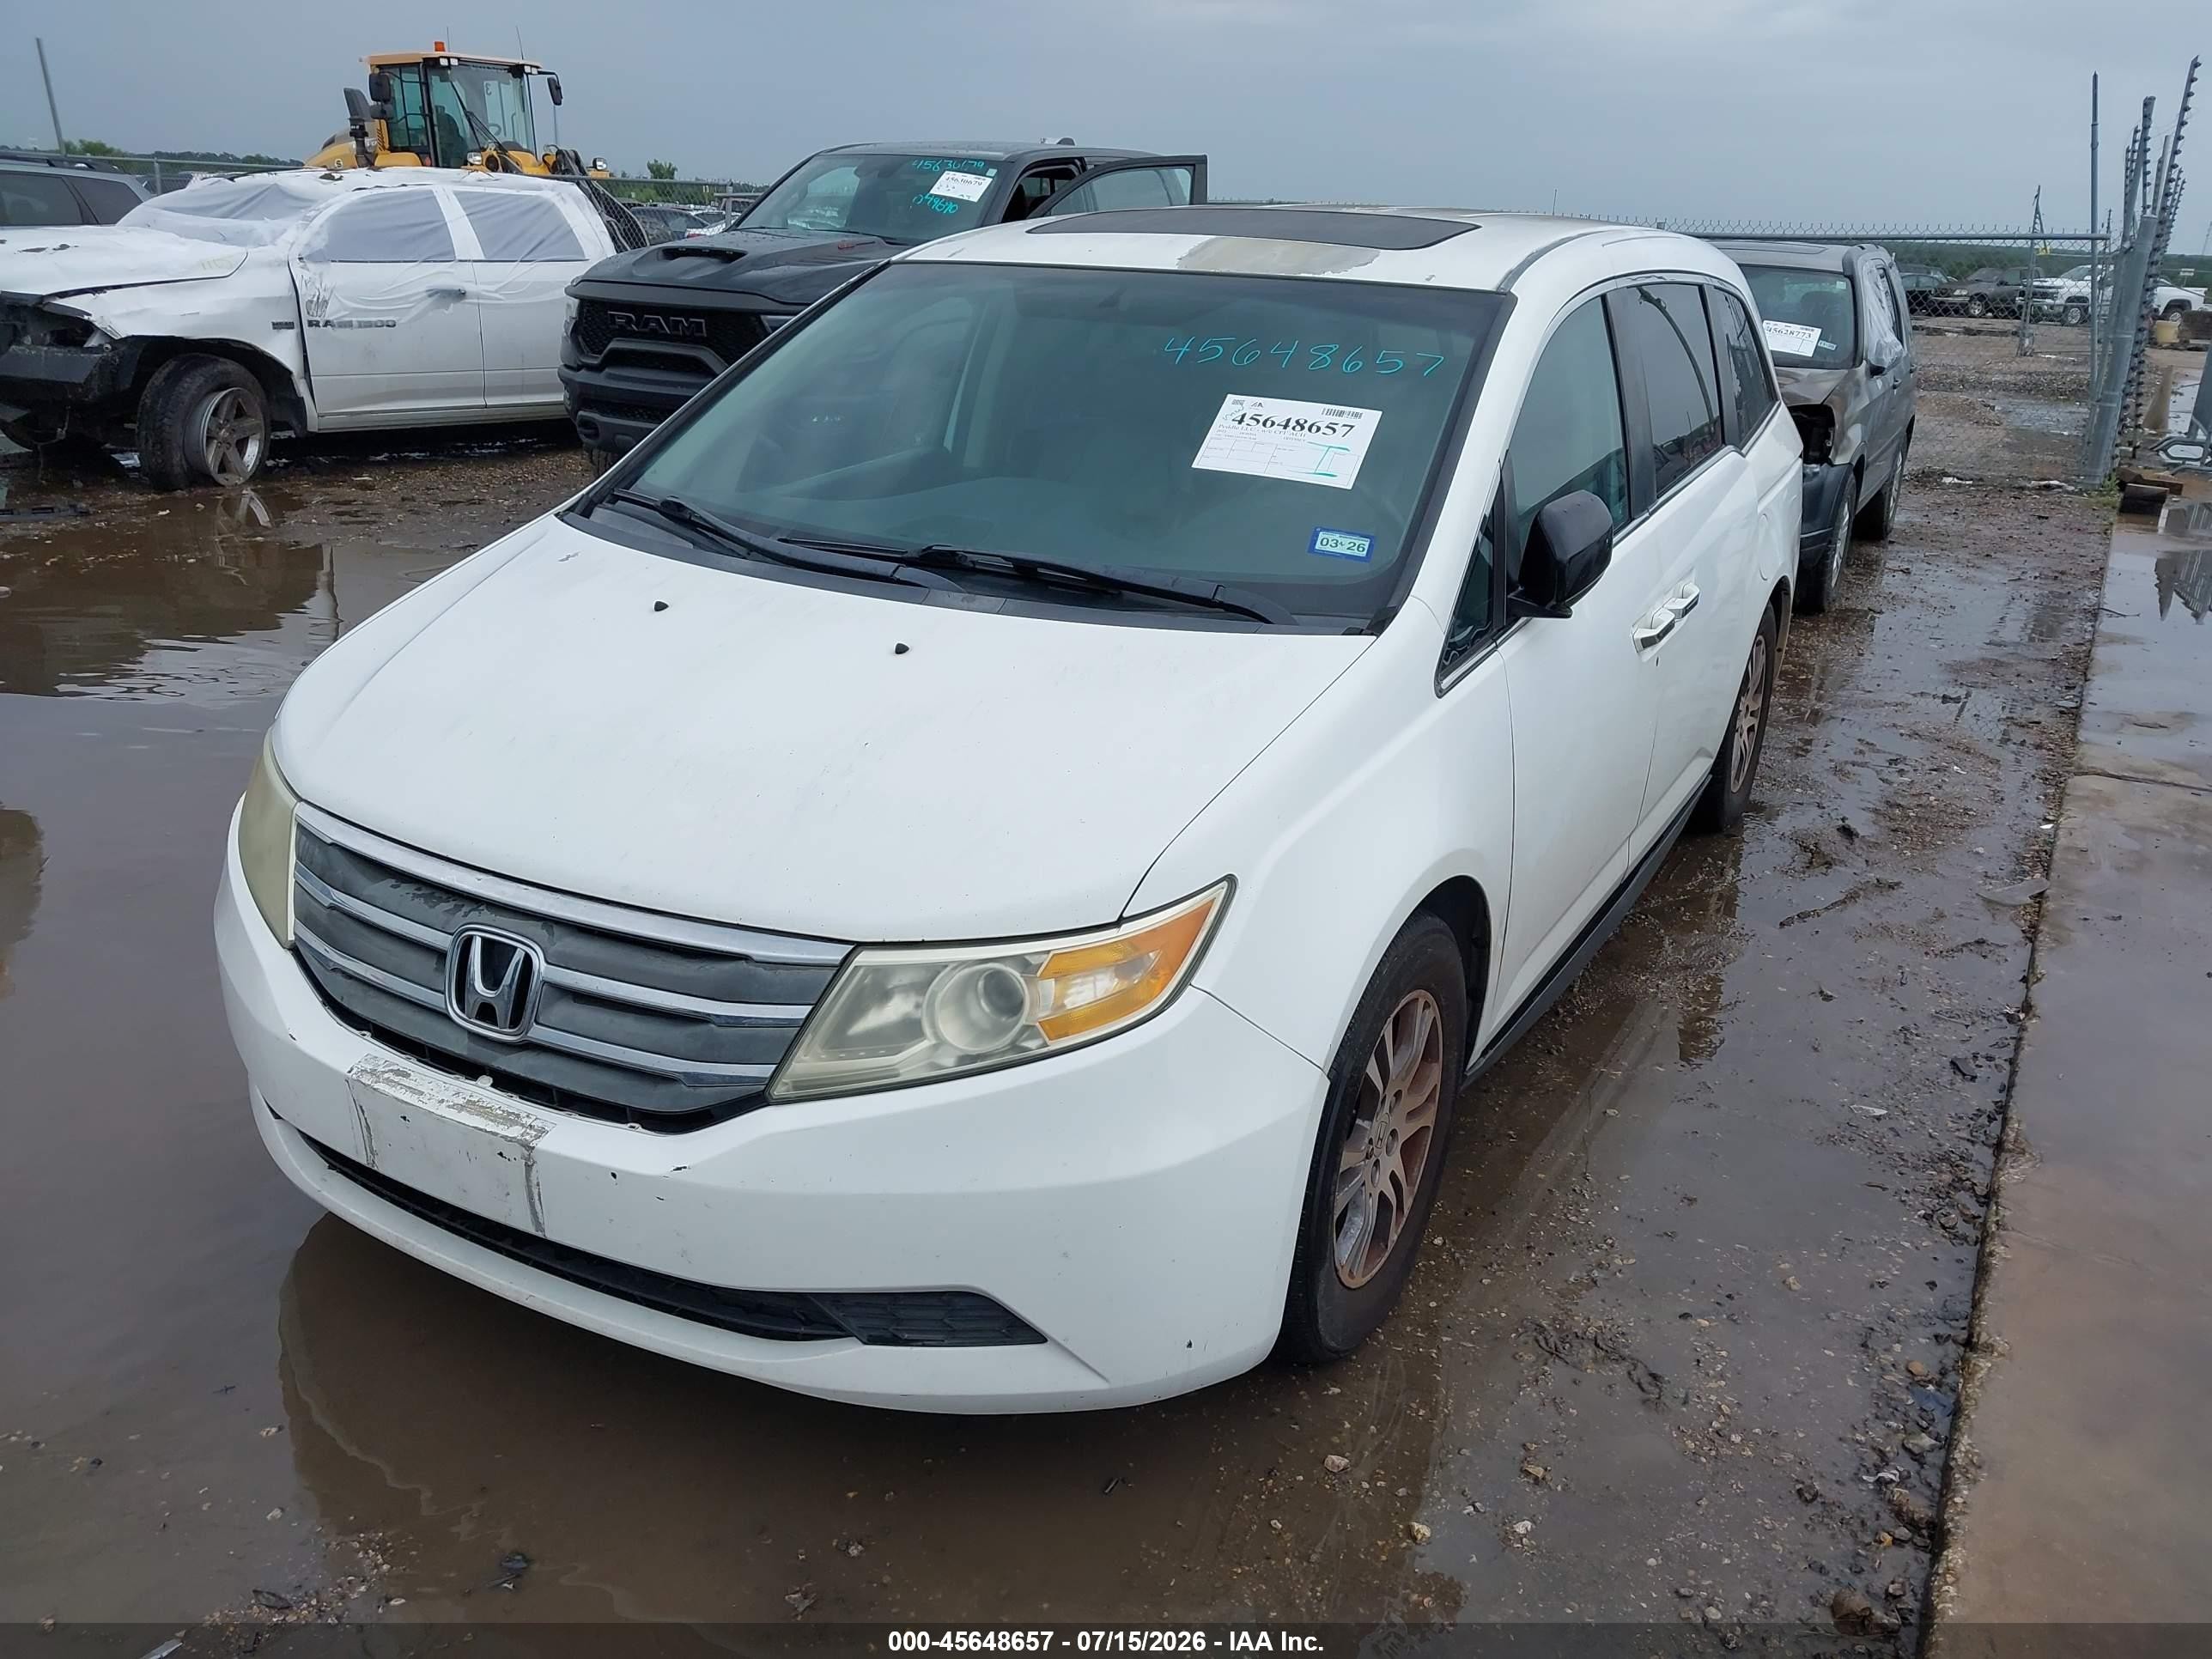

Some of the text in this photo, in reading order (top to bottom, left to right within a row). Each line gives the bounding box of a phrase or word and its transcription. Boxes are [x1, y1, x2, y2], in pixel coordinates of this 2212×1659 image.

[606, 310, 708, 337] RAM
[1164, 336, 1444, 377] 45648657
[1231, 412, 1356, 438] 45648657
